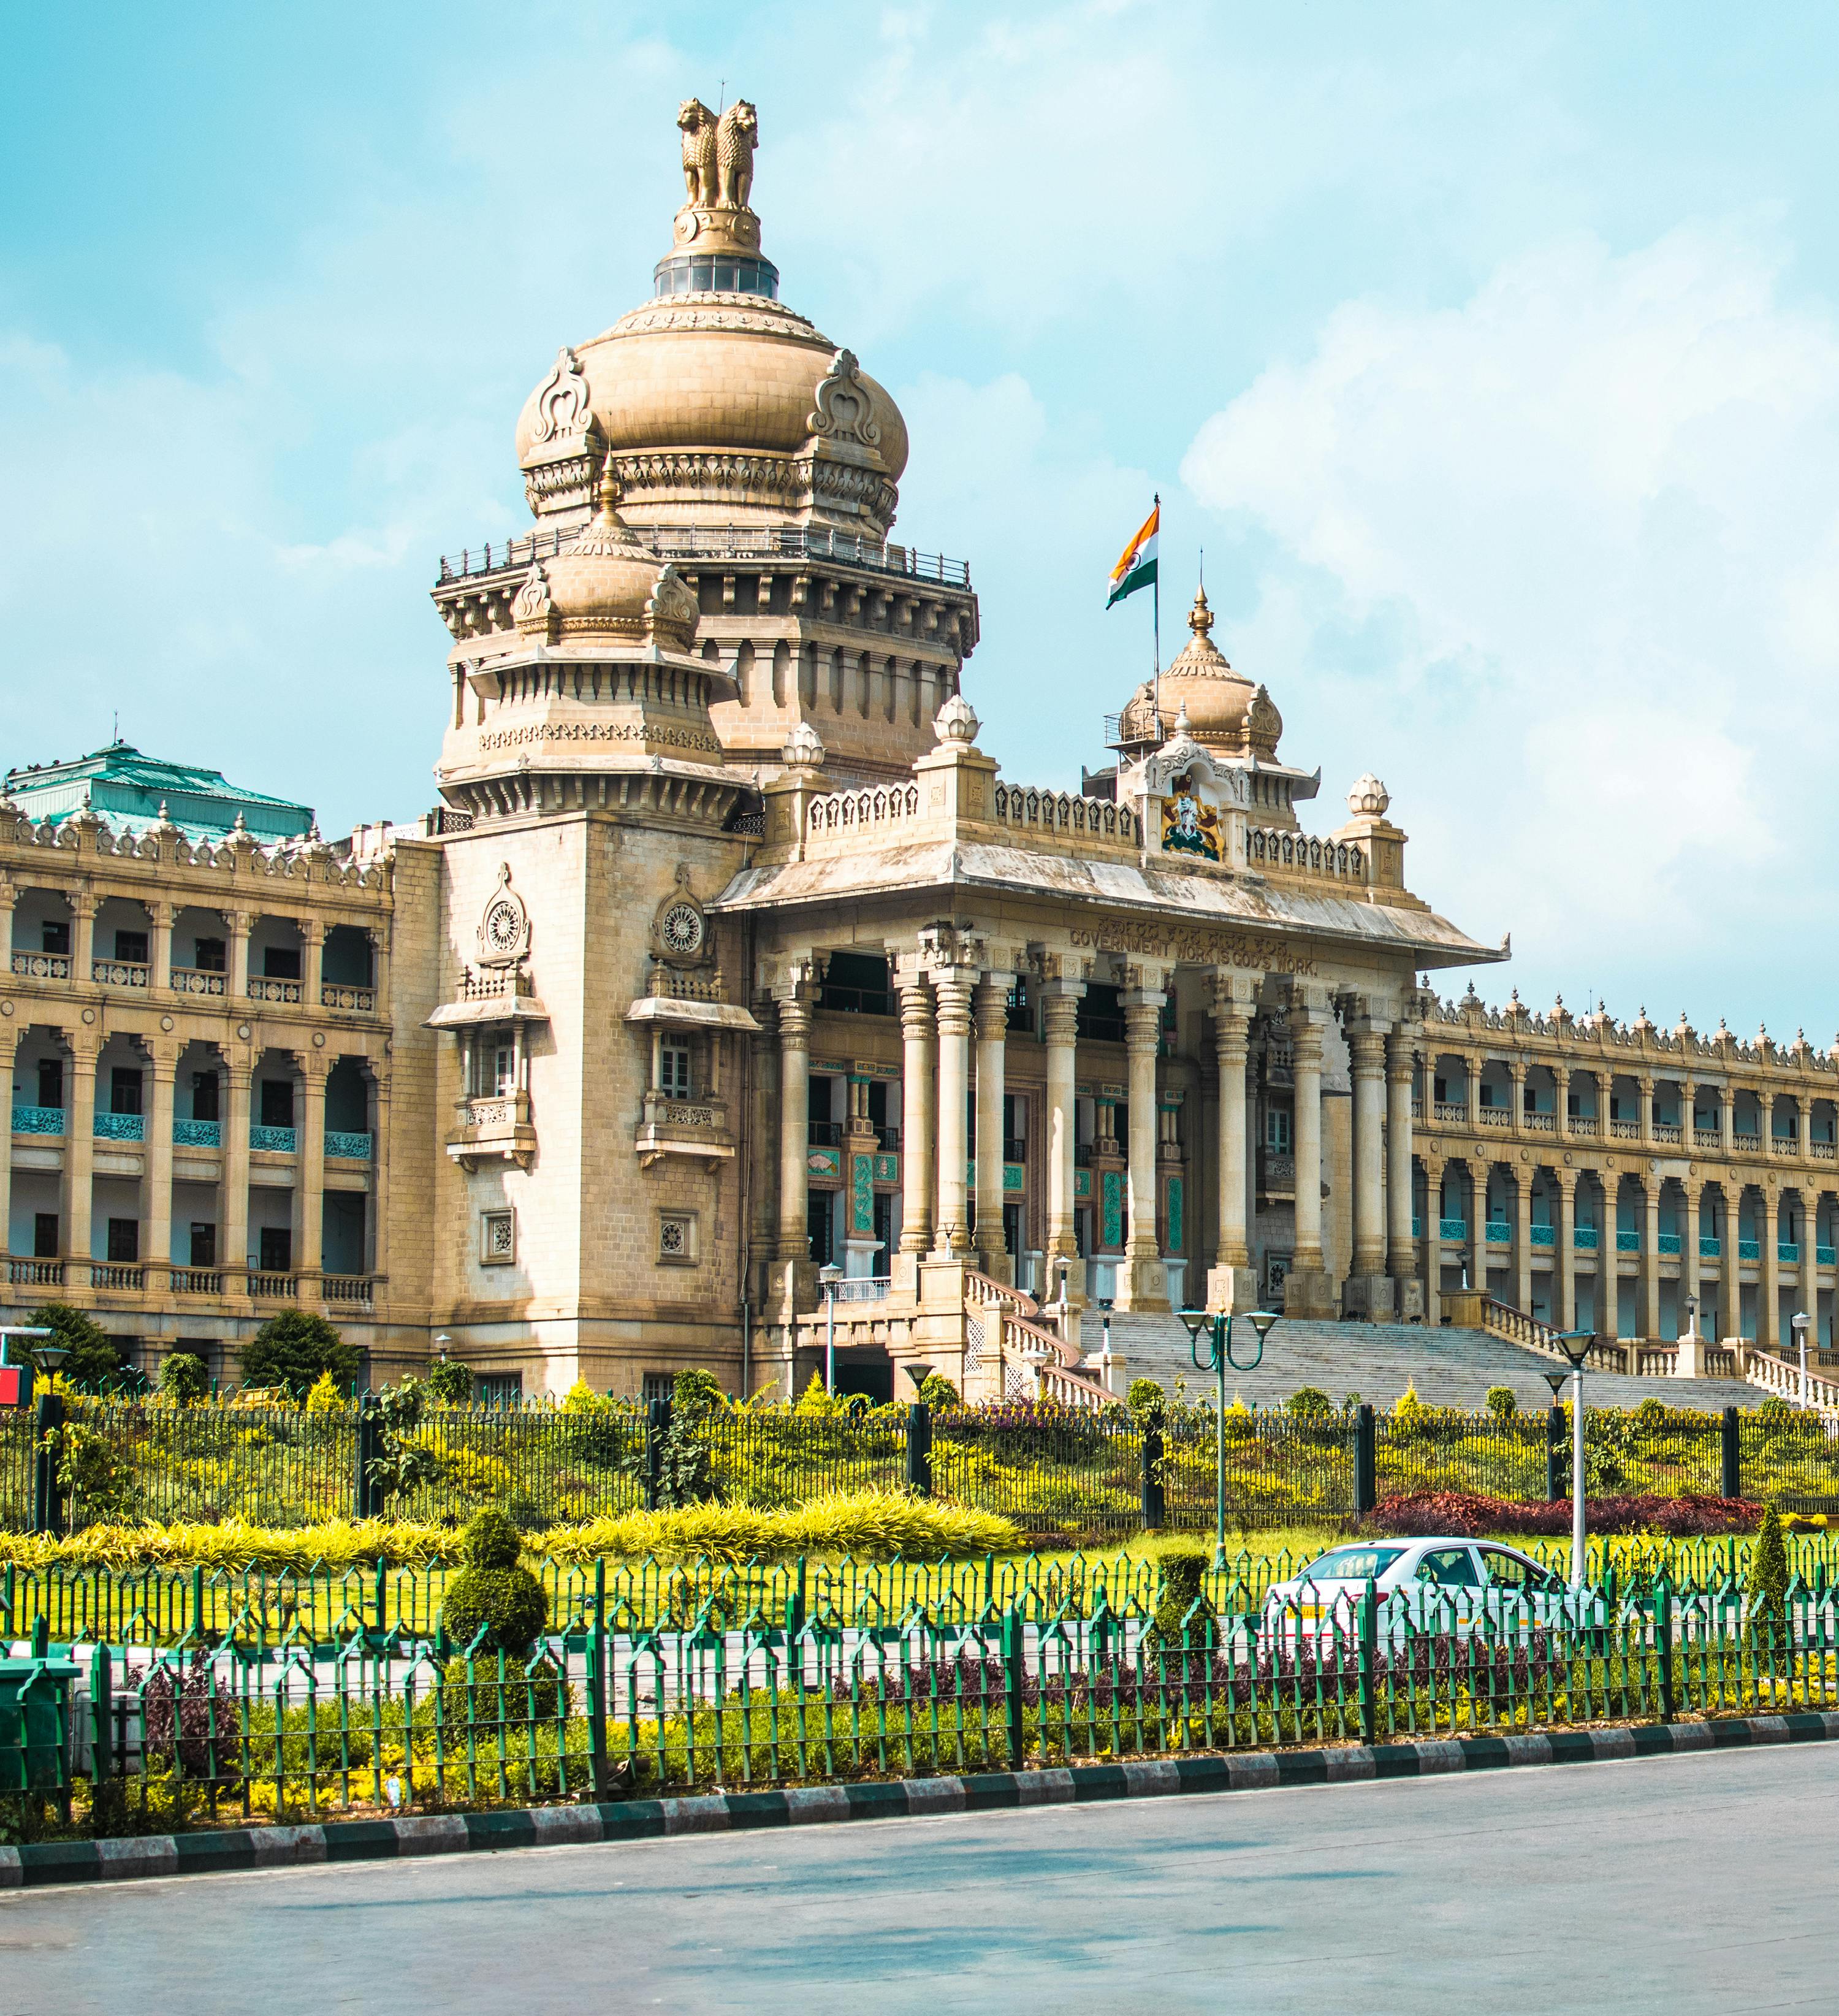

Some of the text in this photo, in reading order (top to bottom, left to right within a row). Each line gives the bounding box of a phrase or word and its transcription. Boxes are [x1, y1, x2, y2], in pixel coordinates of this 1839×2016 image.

[1070, 929, 1170, 956] GOVERNMENT
[1176, 942, 1214, 963] WORK
[1217, 949, 1230, 965] IS
[1233, 950, 1271, 970] GOD'S
